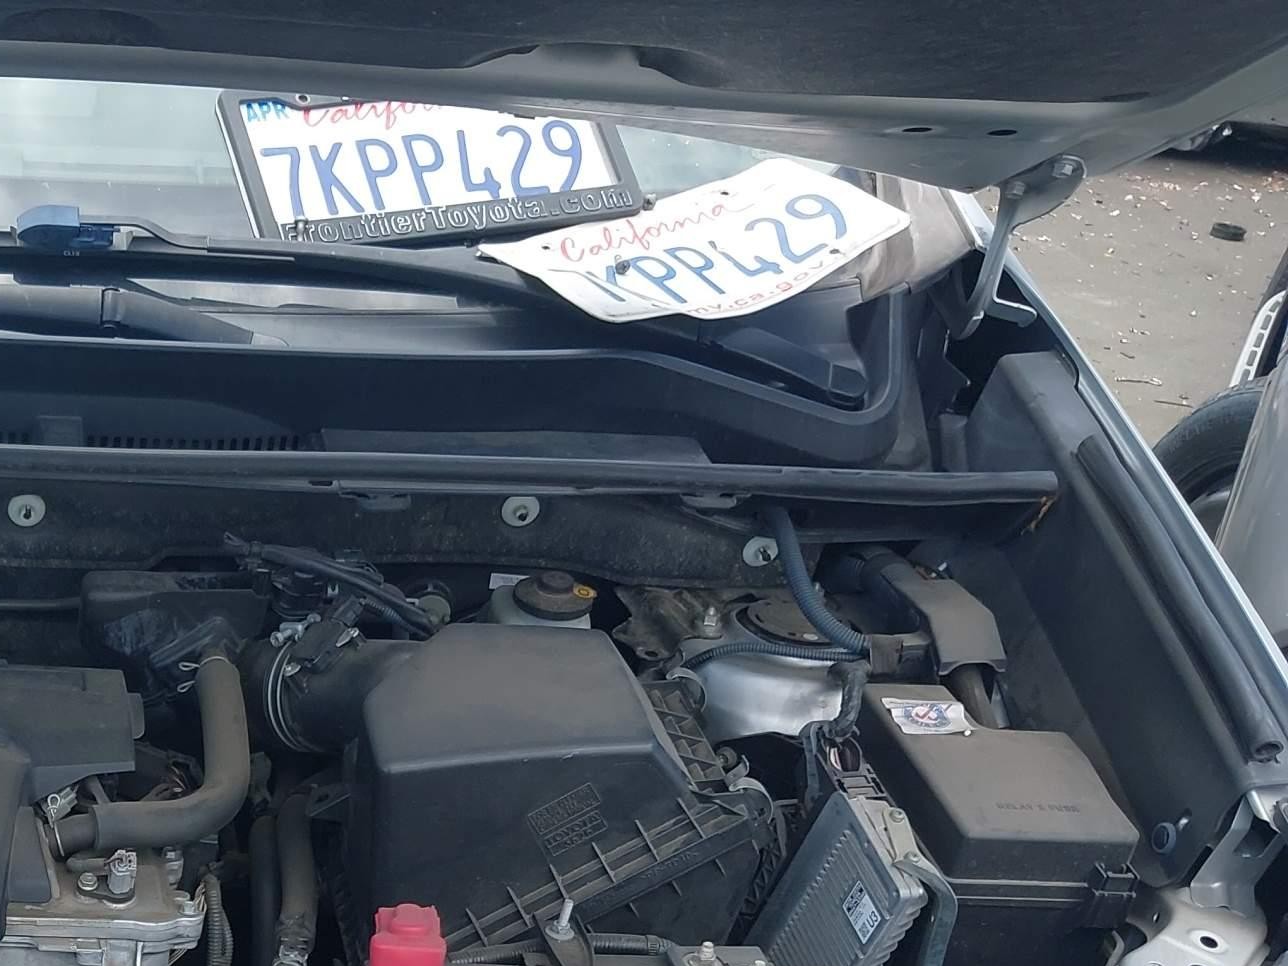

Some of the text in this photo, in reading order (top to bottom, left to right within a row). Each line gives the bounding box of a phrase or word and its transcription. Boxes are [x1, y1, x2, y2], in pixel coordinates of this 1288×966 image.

[260, 119, 583, 216] 7KPP429
[559, 201, 754, 262] California
[586, 193, 848, 305] KPP429
